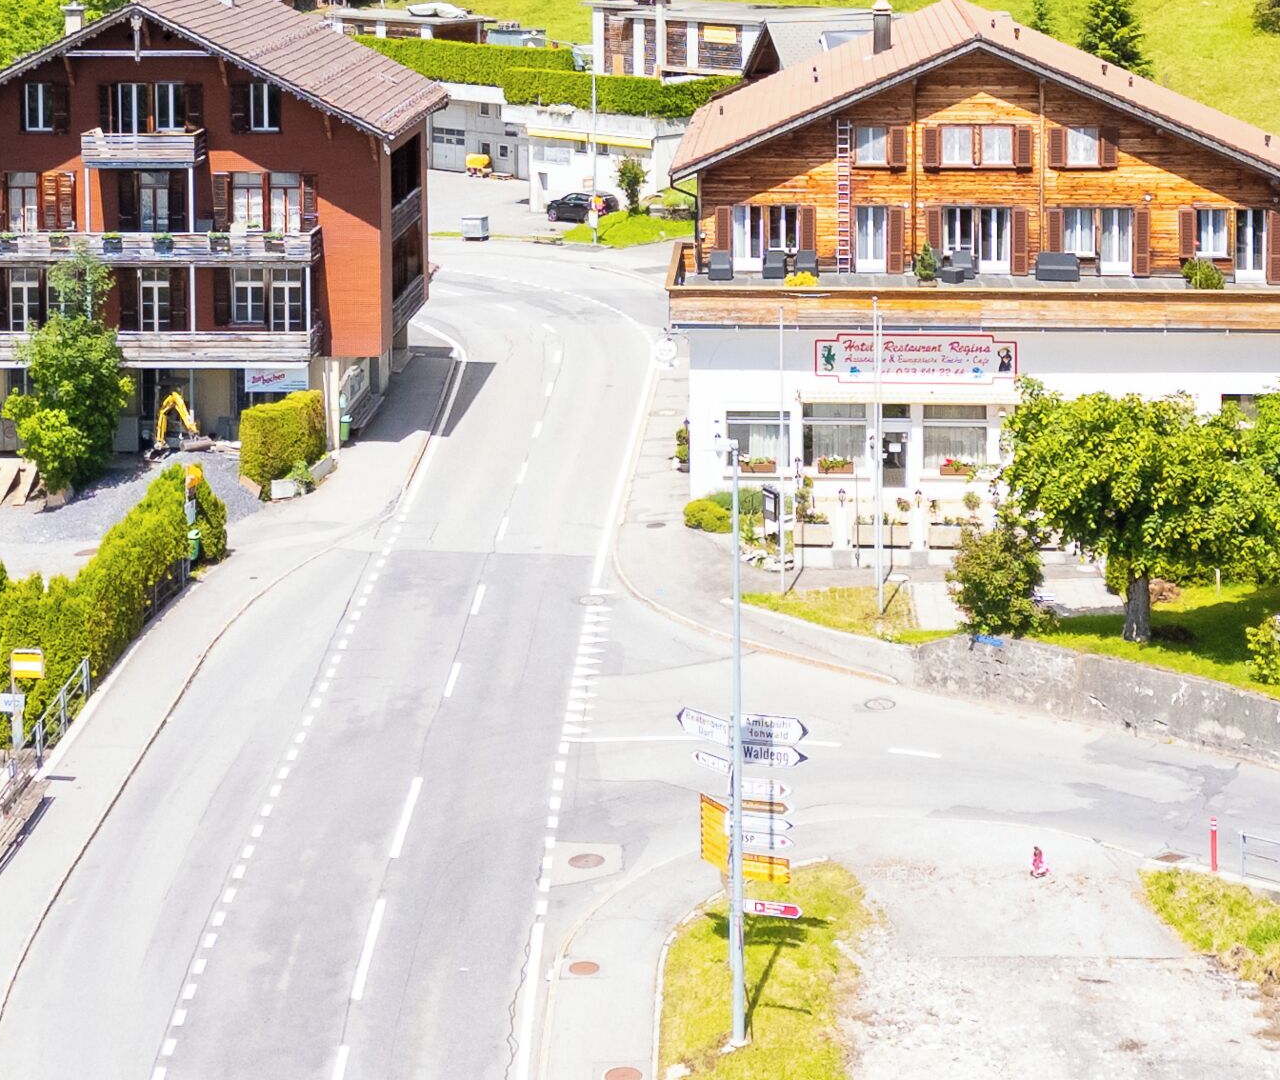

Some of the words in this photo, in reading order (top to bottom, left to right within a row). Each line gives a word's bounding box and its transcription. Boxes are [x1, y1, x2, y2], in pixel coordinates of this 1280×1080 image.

[842, 339, 875, 353] Hotel
[882, 340, 943, 353] Restaurant
[948, 340, 992, 356] Regina
[743, 745, 789, 766] Waldegg
